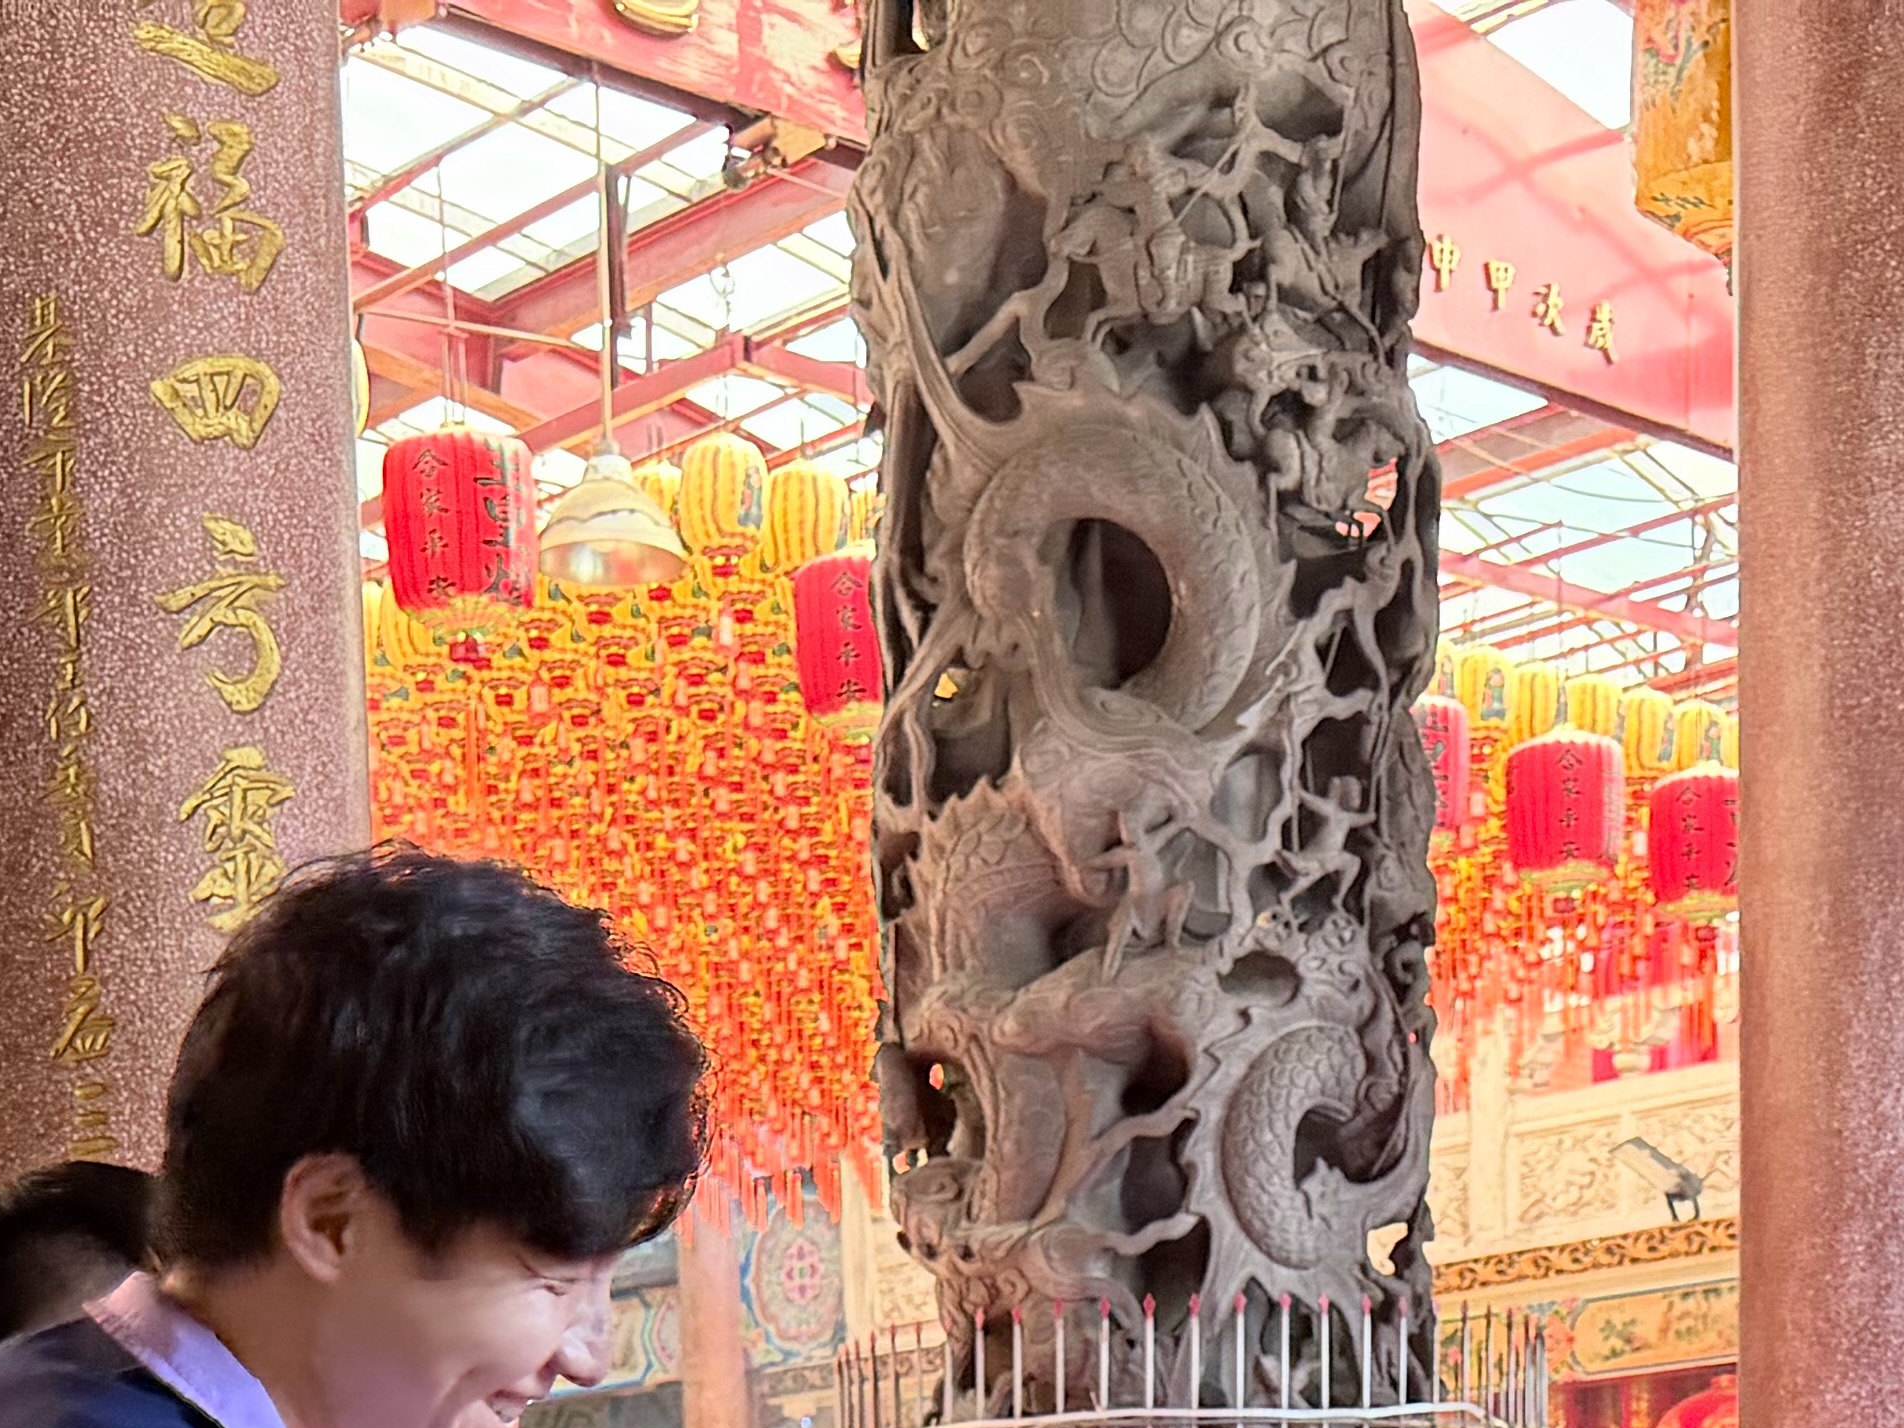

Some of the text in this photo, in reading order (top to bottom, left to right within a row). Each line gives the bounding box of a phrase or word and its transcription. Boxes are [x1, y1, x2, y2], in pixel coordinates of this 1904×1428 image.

[413, 448, 457, 598] 合家平安
[831, 571, 868, 702] 合家平安
